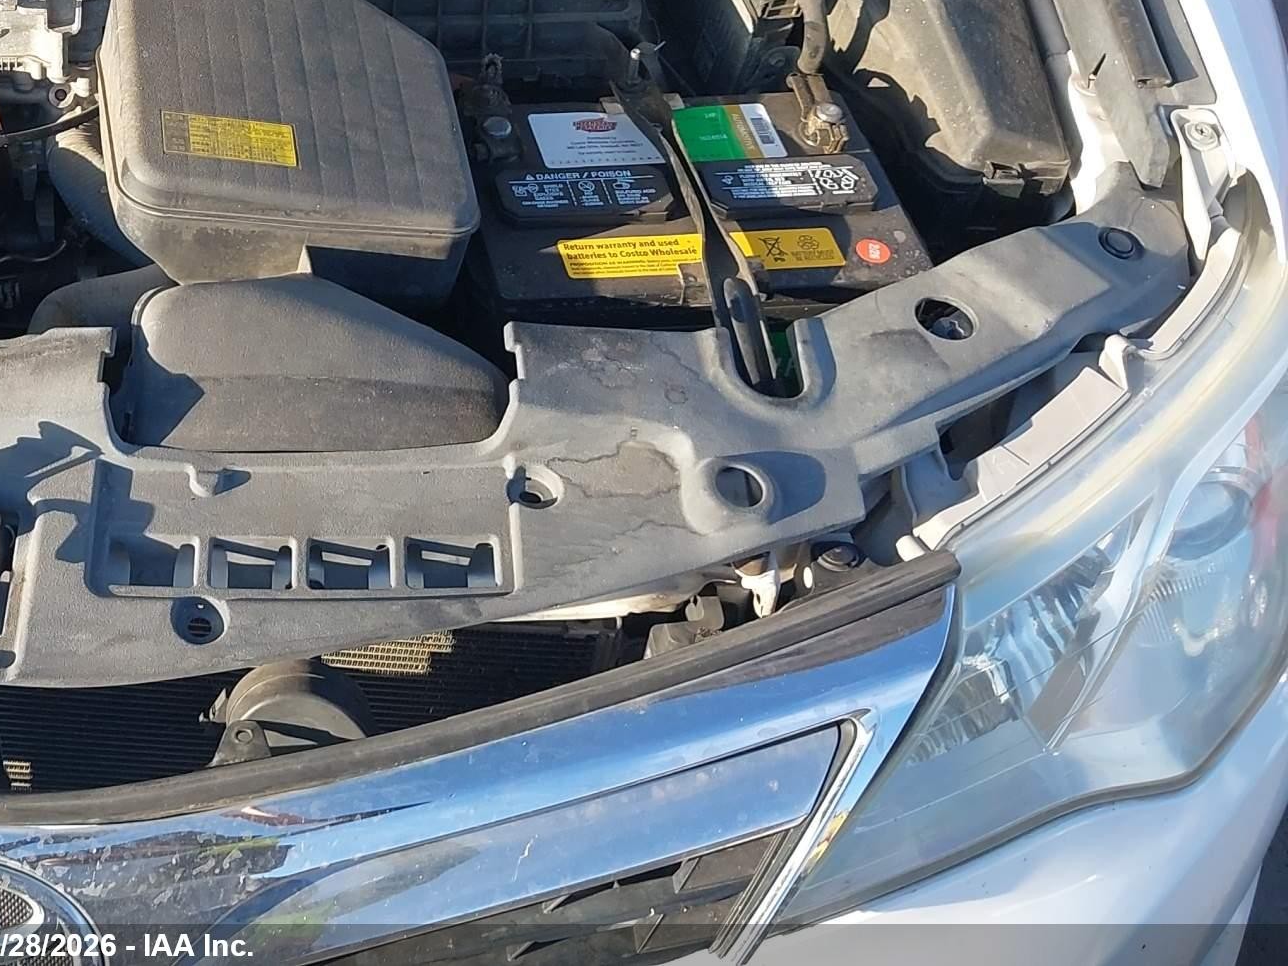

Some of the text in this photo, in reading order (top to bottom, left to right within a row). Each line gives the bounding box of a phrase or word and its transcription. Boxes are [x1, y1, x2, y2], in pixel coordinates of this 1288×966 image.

[535, 172, 581, 181] DANGER
[590, 169, 632, 178] POISON
[563, 238, 680, 251] Return warranty and used
[566, 247, 698, 260] batteries to Costco Wholesale
